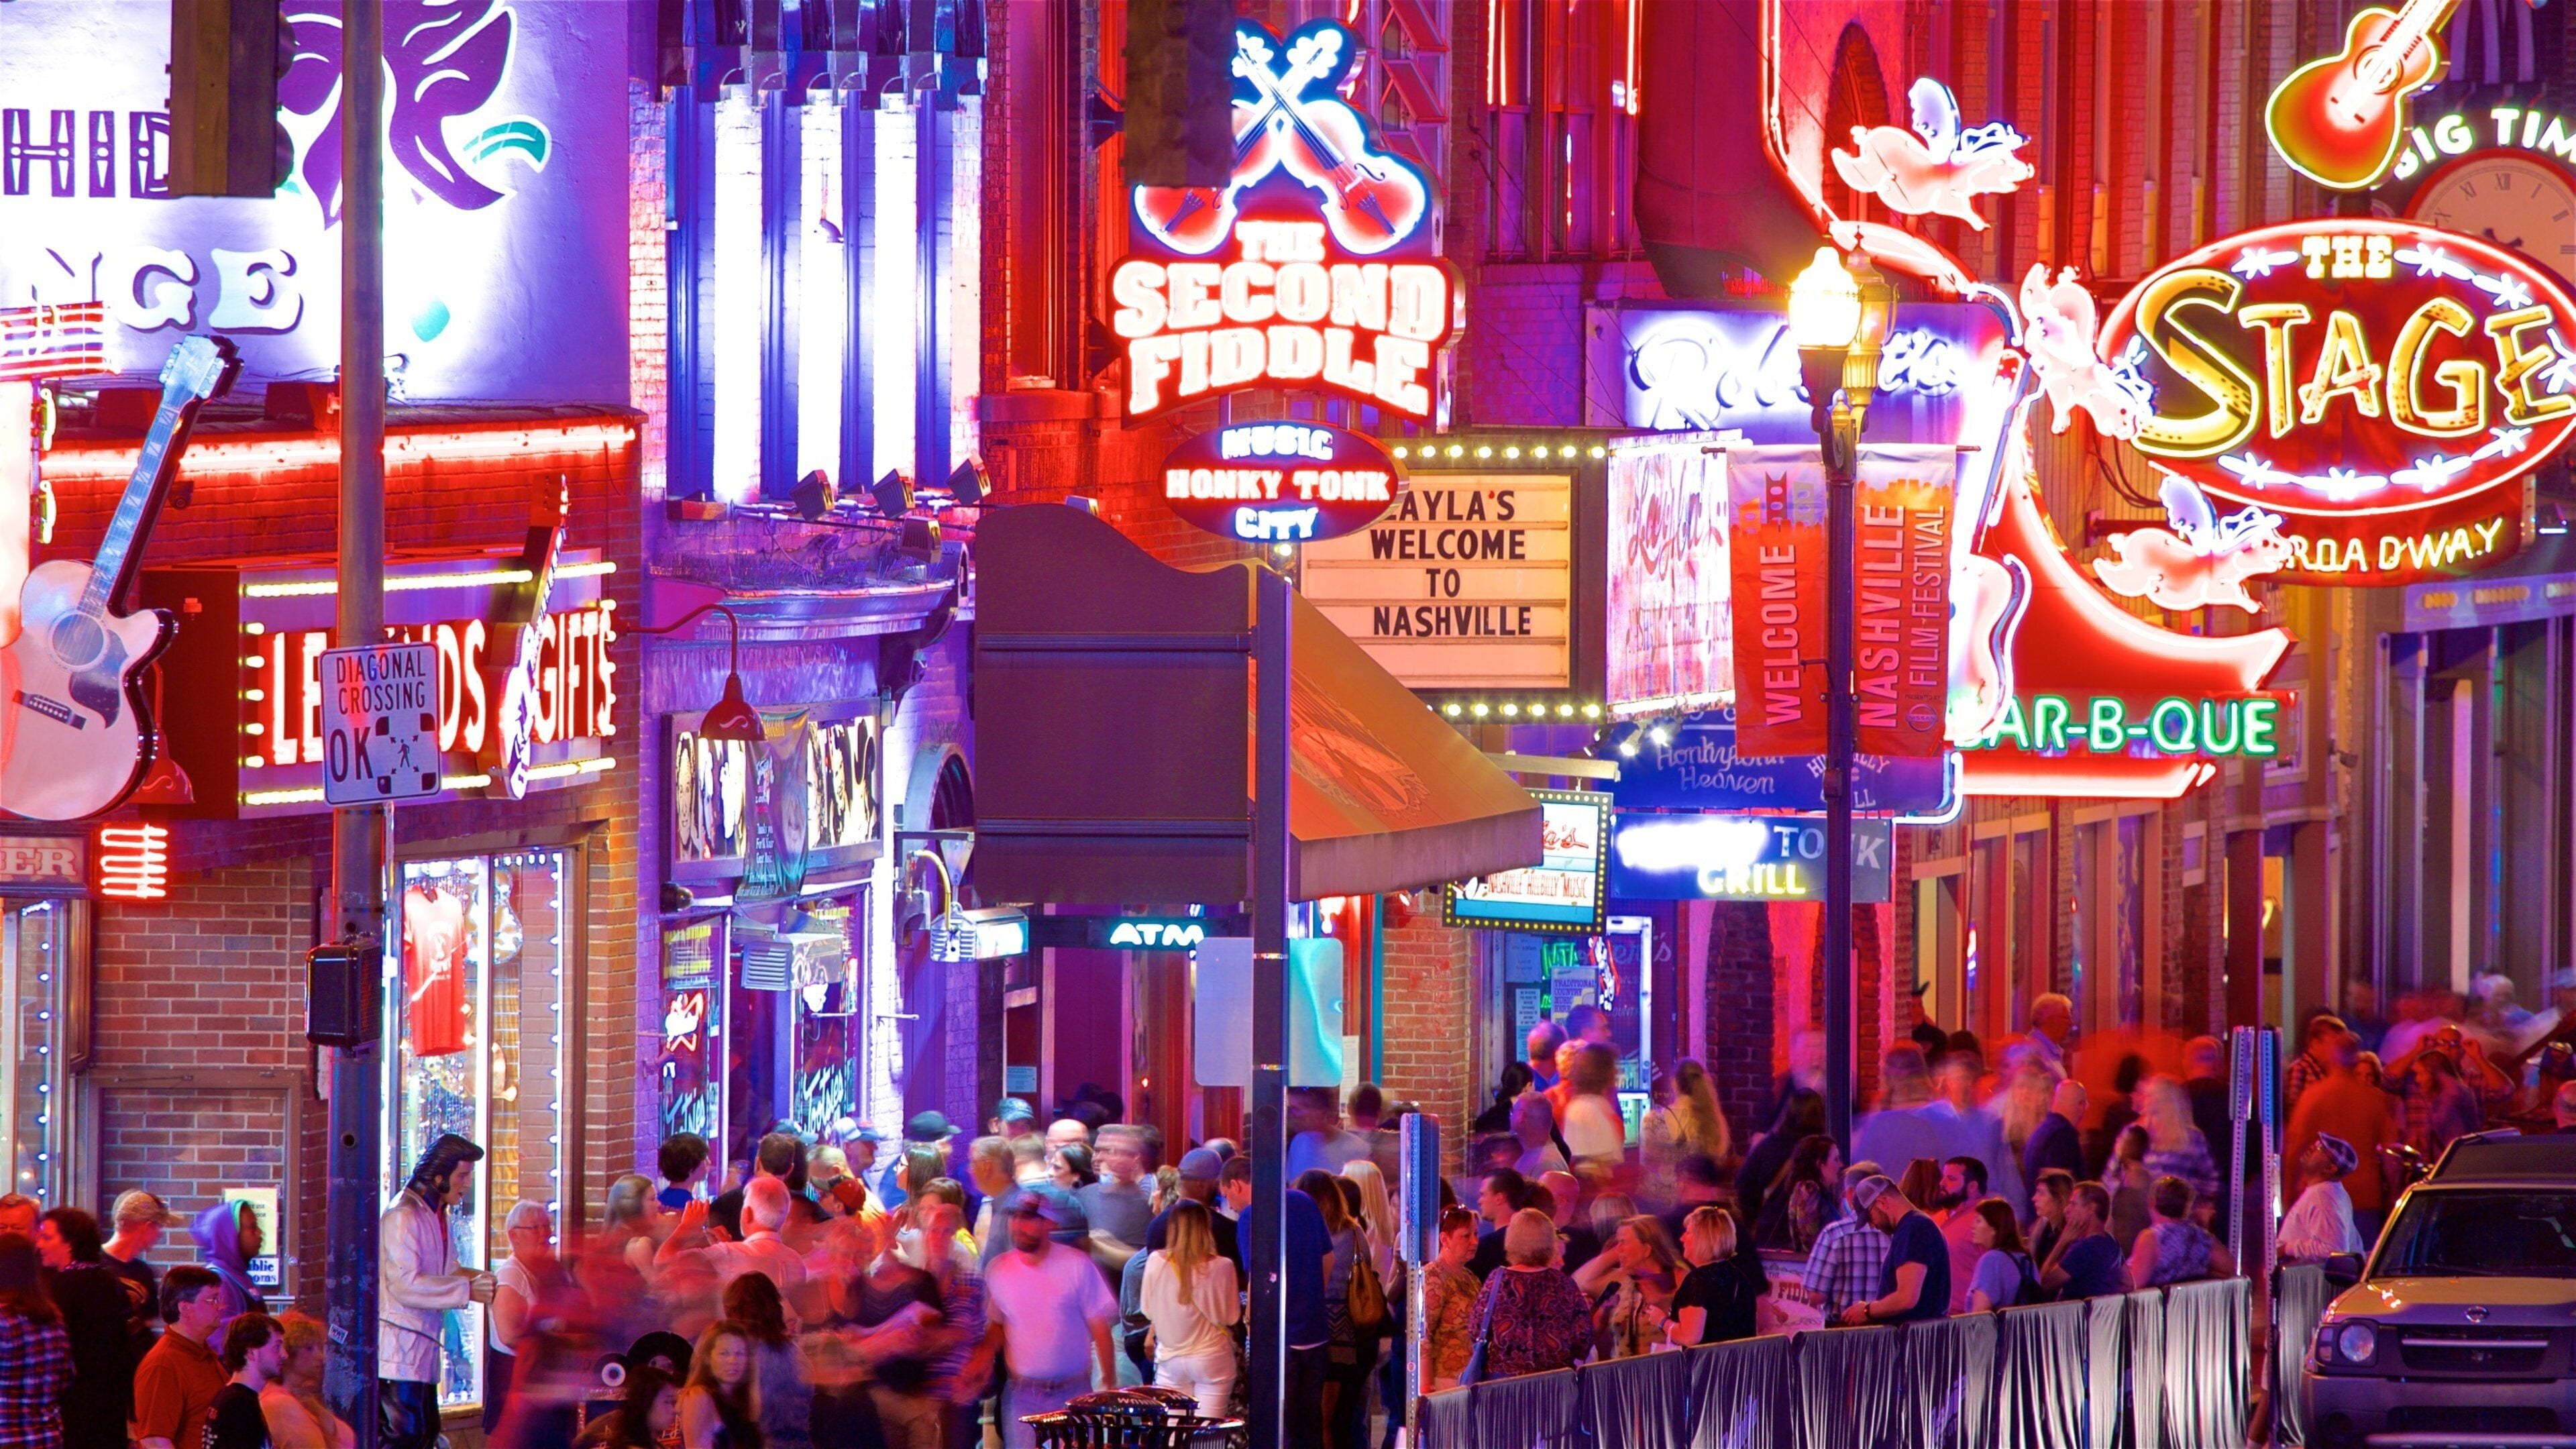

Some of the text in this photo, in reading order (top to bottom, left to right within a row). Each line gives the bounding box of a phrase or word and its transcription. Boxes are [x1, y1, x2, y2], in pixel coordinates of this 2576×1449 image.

[1236, 221, 1326, 261] THE
[2302, 235, 2393, 279] THE
[1112, 261, 1448, 342] SECOND
[1128, 325, 1430, 416] FIDDLE
[2129, 268, 2576, 459] STAGE
[1221, 425, 1334, 460] MUSIC
[1165, 470, 1390, 500] HONKY TONK
[1235, 507, 1319, 539] CITY
[1385, 490, 1515, 521] AYLA'S
[1370, 529, 1525, 560] WELCOME
[1426, 568, 1460, 598] TO
[1909, 504, 1944, 686] FILM FESTIVAL
[1374, 606, 1531, 637] NASHVILLE
[1859, 504, 1904, 728] NASHVILLE
[1760, 544, 1801, 727] WELCOME
[336, 650, 426, 684] DIAGONAL
[537, 609, 615, 745] GIFTS
[338, 682, 425, 715] CROSSING
[1953, 694, 2275, 756] AR-B-QUE
[329, 727, 373, 783] OK
[1679, 765, 1775, 794] Heaven
[1773, 825, 1886, 869] TOK
[1563, 875, 1587, 898] MUSIC
[1698, 863, 1806, 895] GRILL
[1110, 922, 1204, 946] ATM
